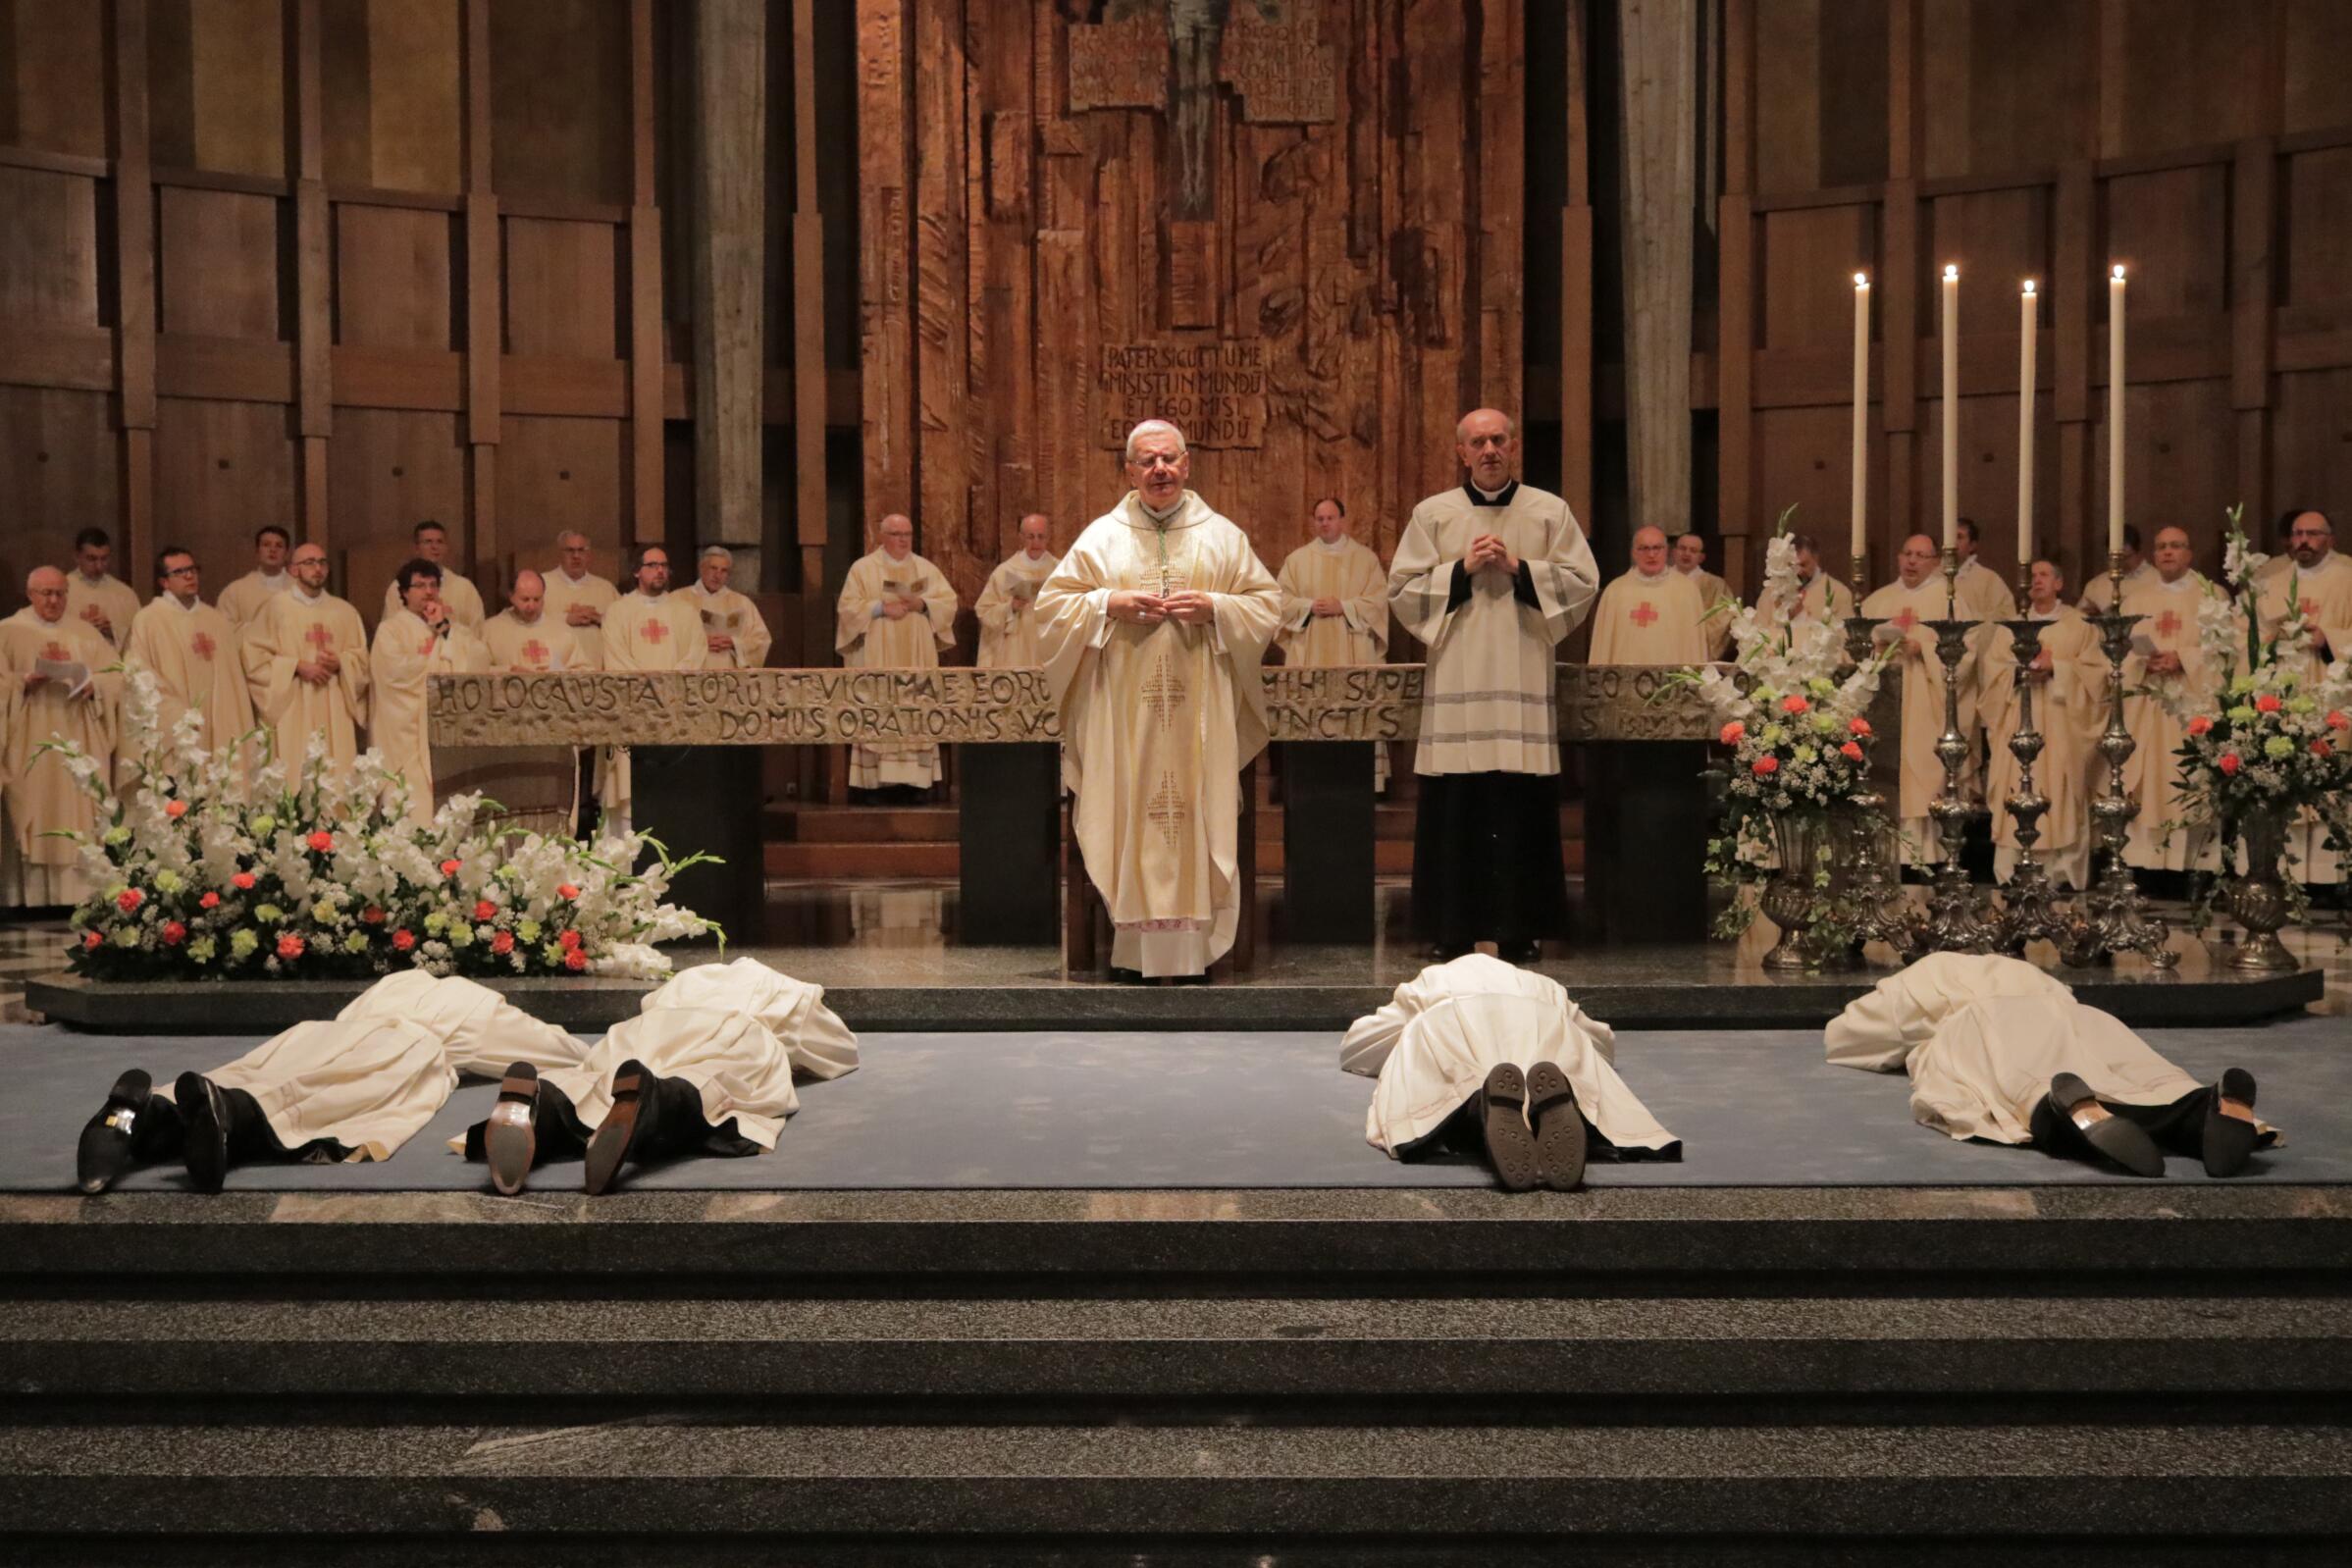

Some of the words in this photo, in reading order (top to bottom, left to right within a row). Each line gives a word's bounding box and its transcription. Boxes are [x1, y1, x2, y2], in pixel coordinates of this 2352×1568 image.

[1108, 346, 1158, 369] PATER
[1162, 346, 1207, 368] SICUT
[1238, 346, 1262, 367] ME
[1109, 372, 1170, 395] MISISTI
[1176, 372, 1194, 393] IN
[1125, 397, 1149, 417] ET
[1155, 396, 1192, 416] EGO
[1198, 396, 1240, 417] MISI
[438, 675, 664, 712] HOLOCAUSTA
[775, 673, 810, 706] ET
[819, 672, 959, 705] VICTIMAE
[1345, 670, 1425, 700] SUPE
[717, 707, 827, 739] DOMUS
[837, 707, 1001, 739] ORATIONIS
